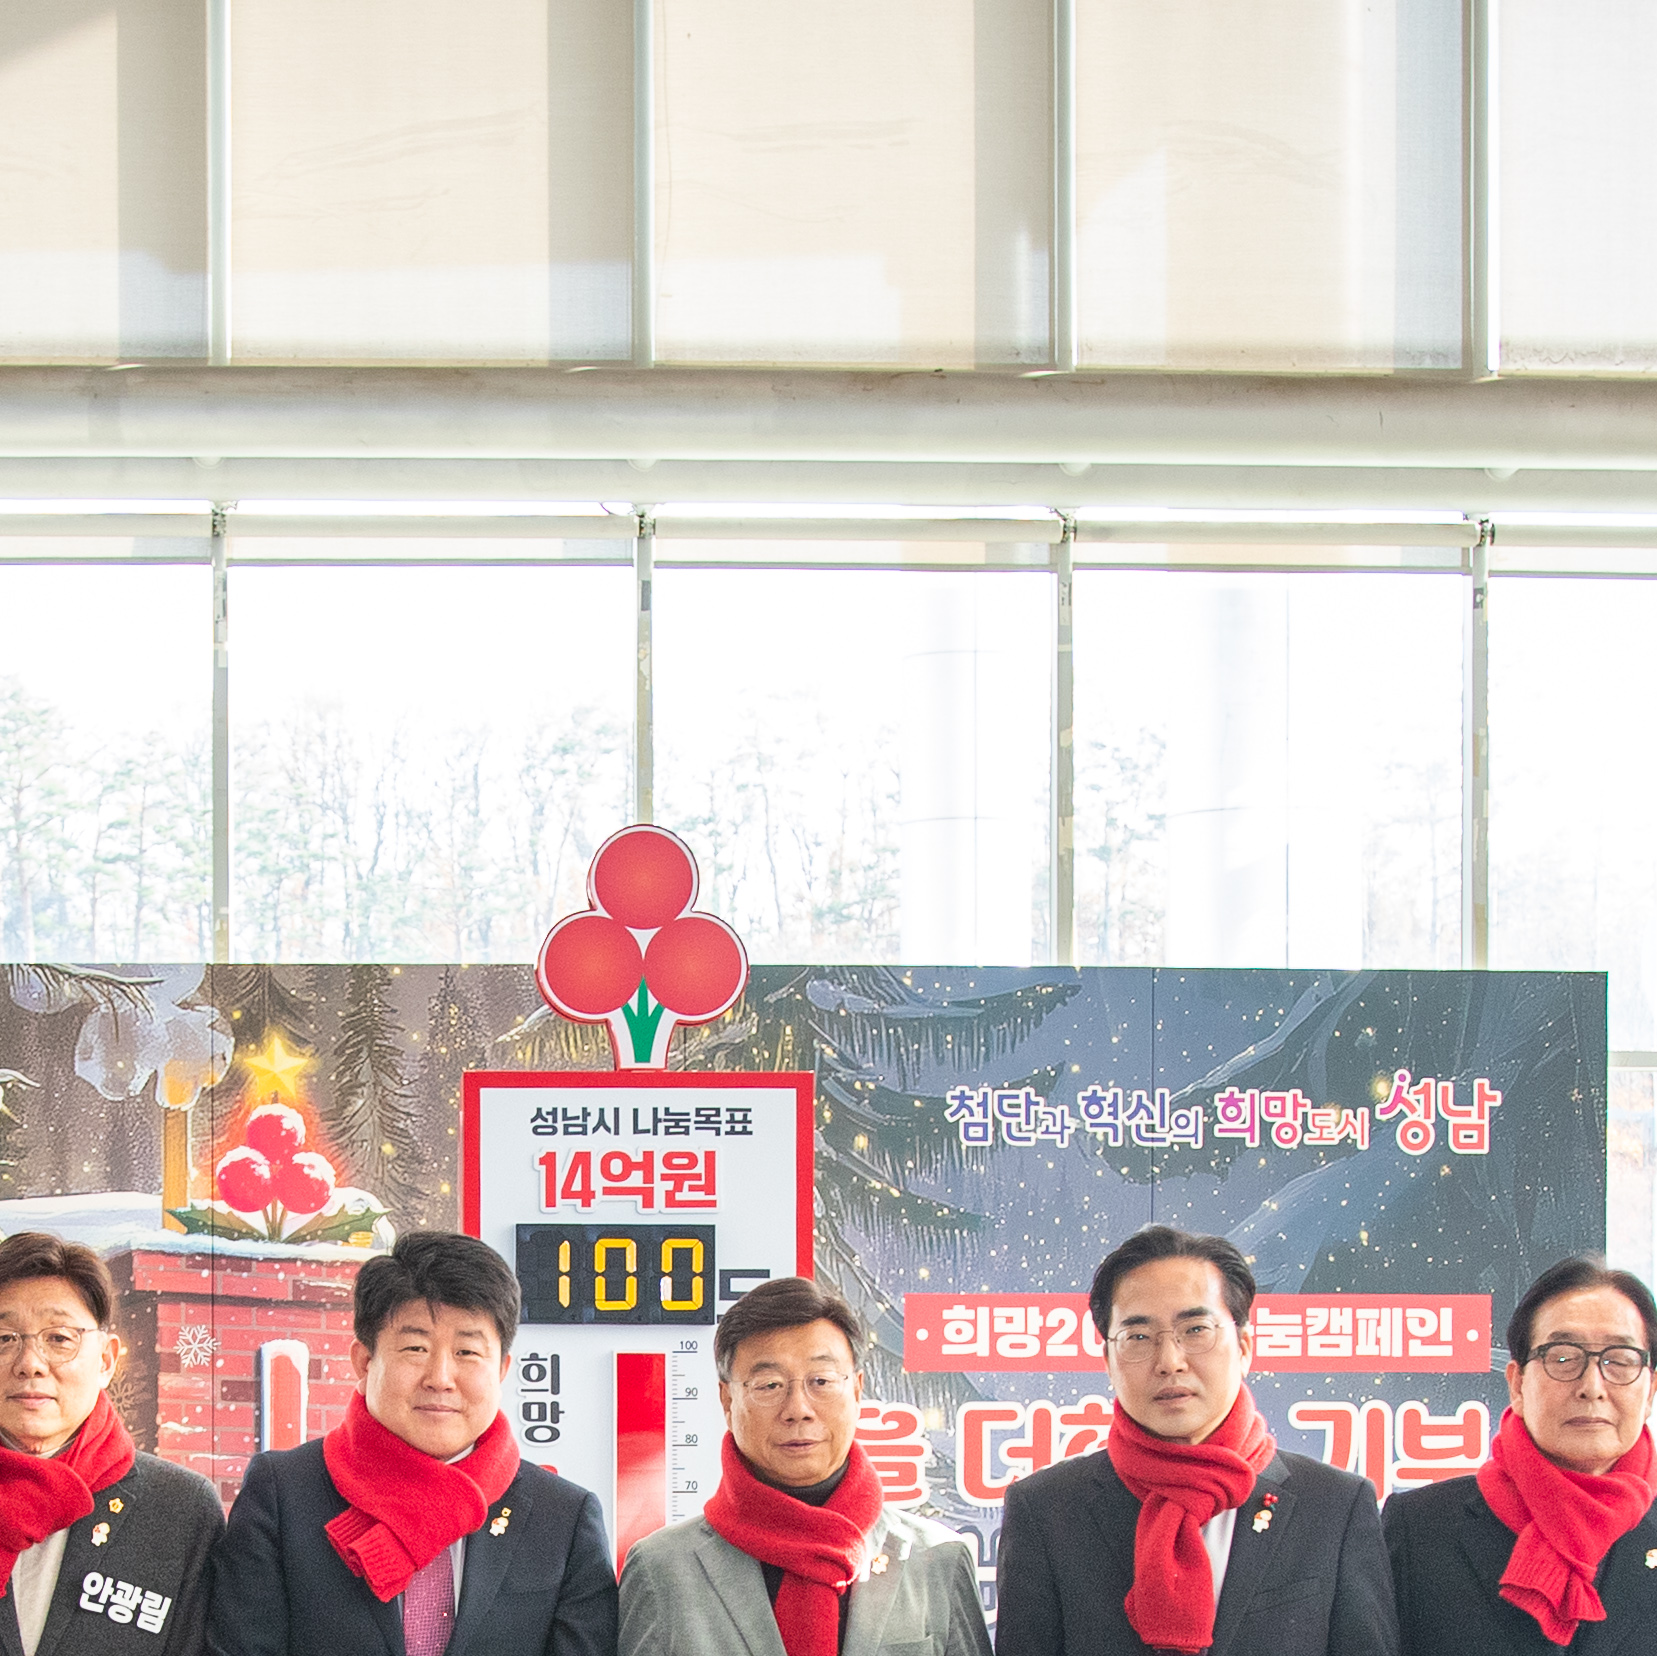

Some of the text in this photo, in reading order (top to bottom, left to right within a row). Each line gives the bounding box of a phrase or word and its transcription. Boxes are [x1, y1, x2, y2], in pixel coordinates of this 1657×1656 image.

[530, 1106, 753, 1137] 성남시 나눔목표
[946, 1068, 1501, 1155] 첨단과 혁신의 희망도시 성남
[538, 1149, 718, 1209] 14억원
[558, 1237, 705, 1311] 100
[679, 1340, 699, 1351] 100
[520, 1352, 566, 1444] 희망
[685, 1387, 699, 1398] 90
[685, 1433, 699, 1444] 80
[685, 1480, 699, 1491] 70
[79, 1571, 172, 1634] 안광림
